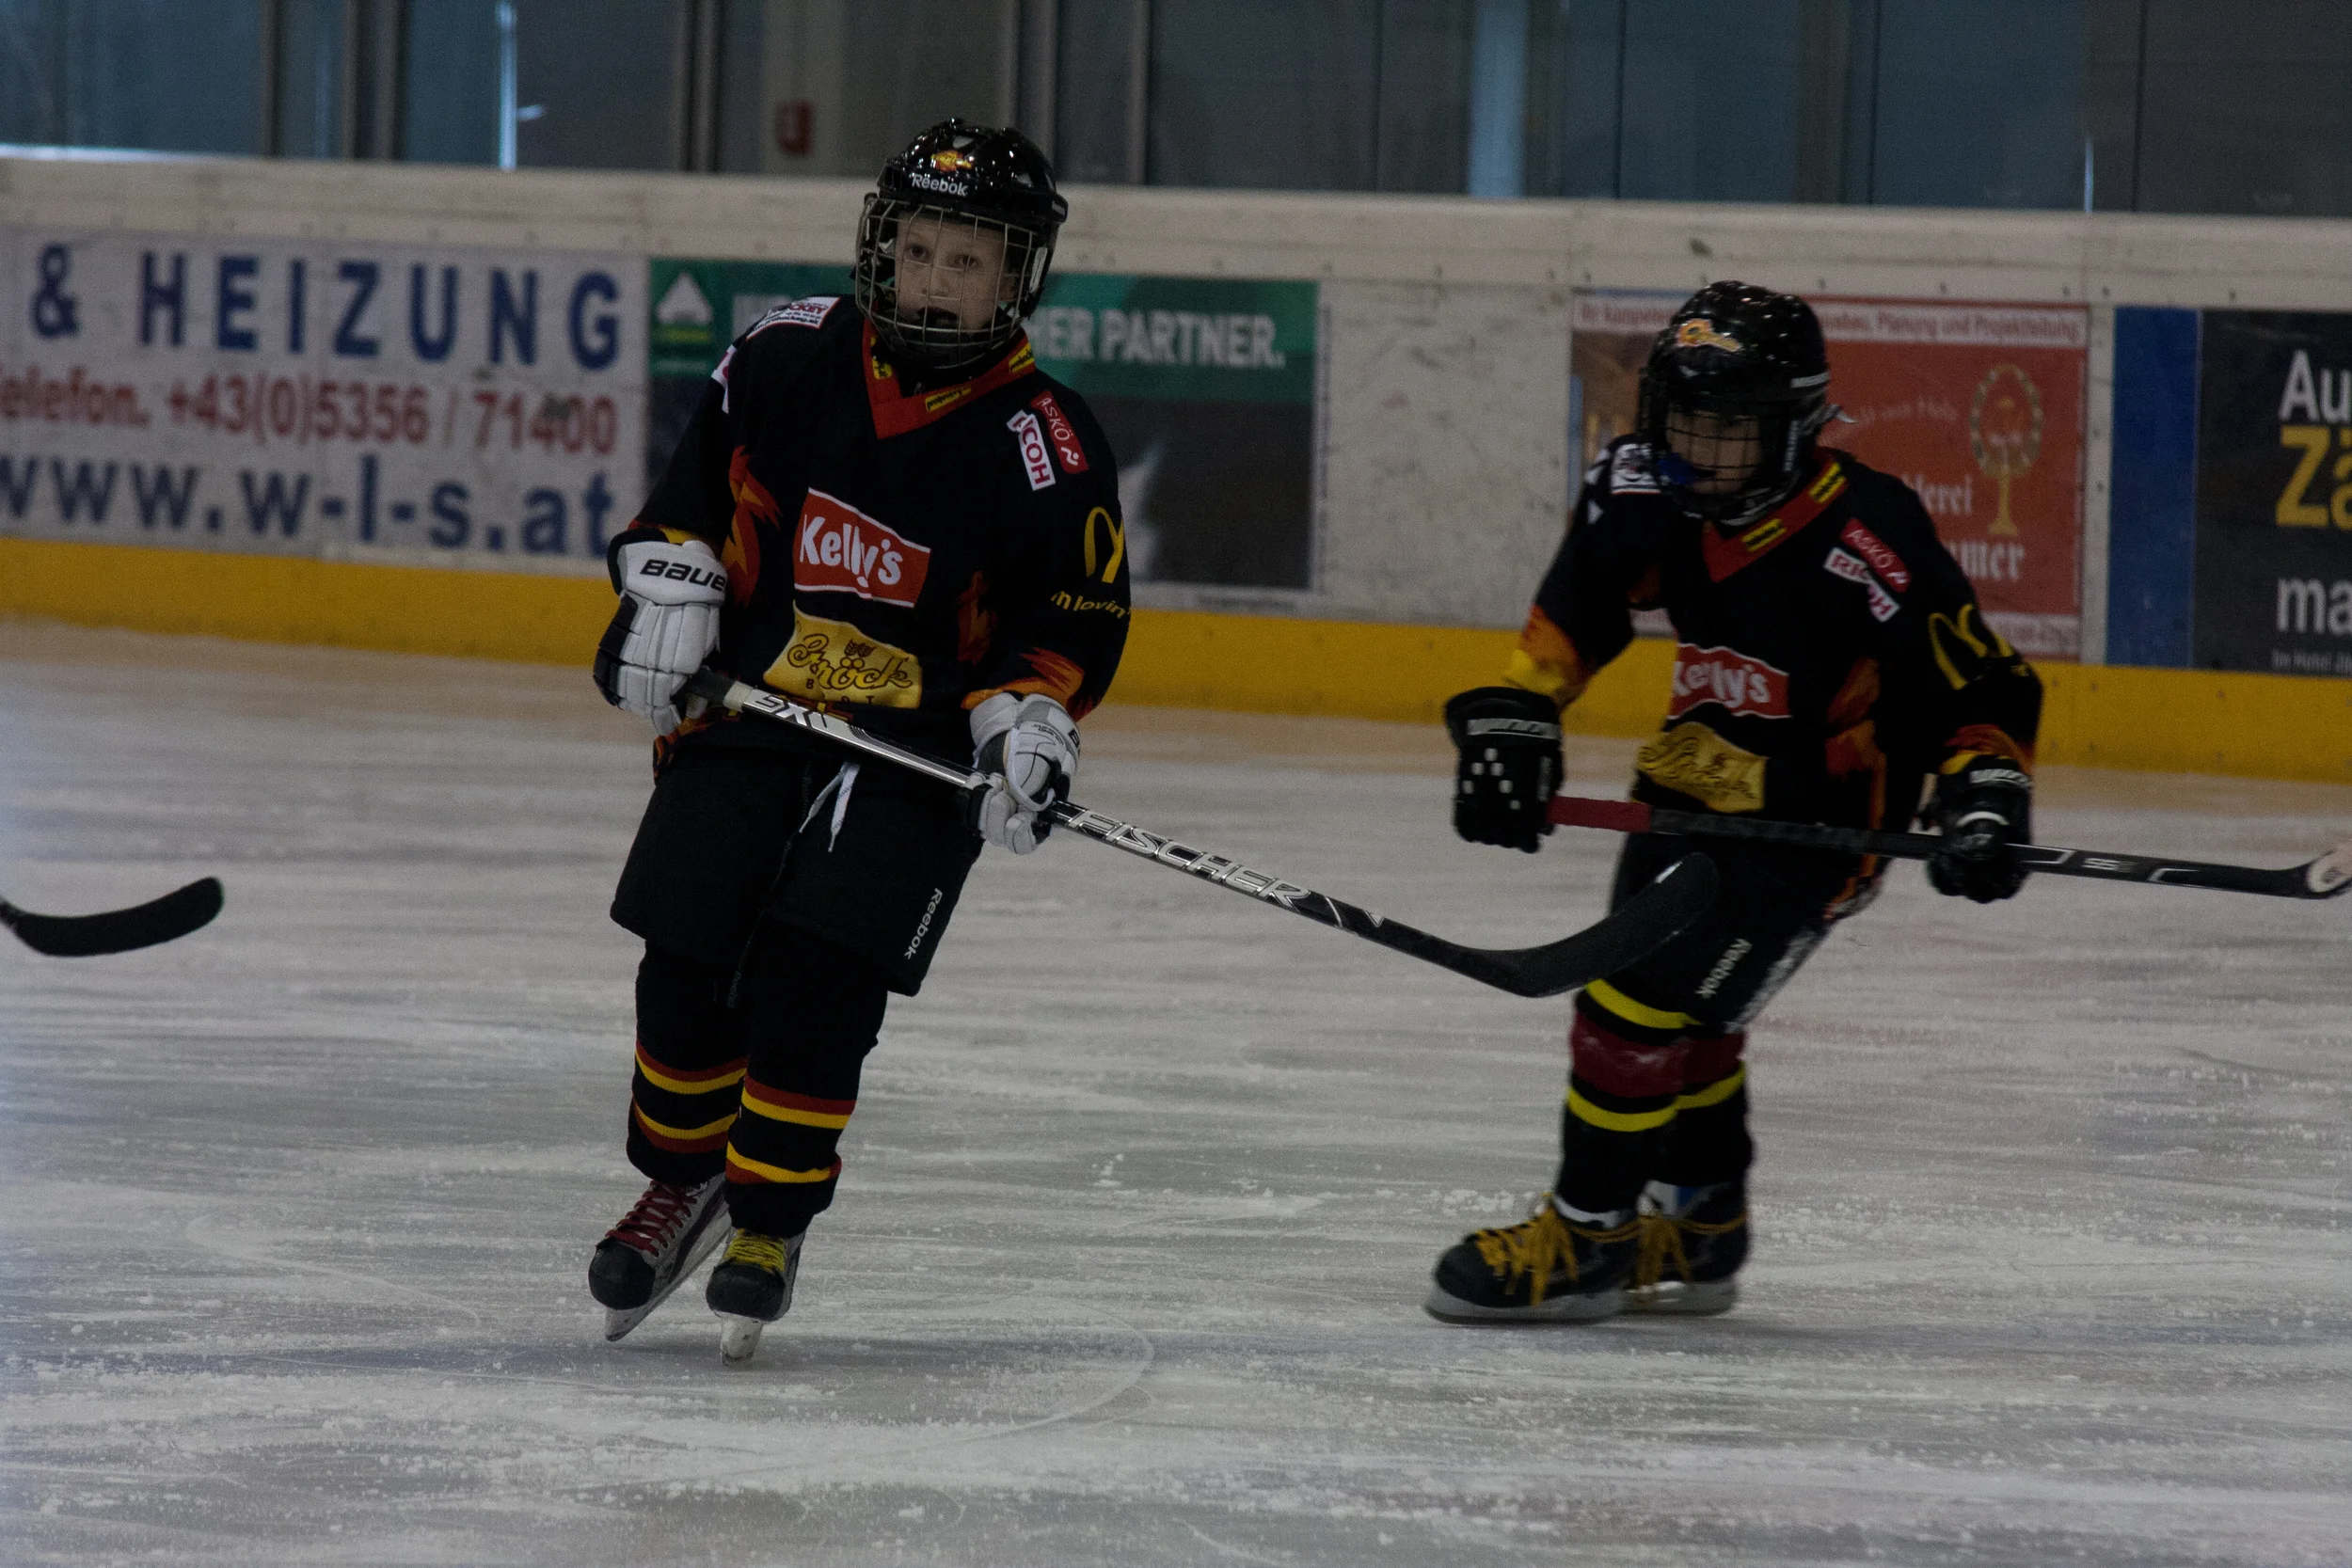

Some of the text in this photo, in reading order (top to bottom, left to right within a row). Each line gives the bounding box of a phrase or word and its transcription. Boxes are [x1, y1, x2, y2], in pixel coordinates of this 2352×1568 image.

[911, 173, 968, 197] Reebok
[33, 244, 78, 339] &
[140, 251, 619, 370] HEIZUNG
[1098, 308, 1286, 368] PARTNER.
[0, 366, 151, 426] elefon.
[167, 373, 429, 447] +43(0)5356
[473, 392, 618, 453] 71400
[1037, 397, 1075, 441] ASKÖ
[800, 514, 903, 588] Kelly's
[1066, 809, 1311, 913] FISCHER
[904, 887, 943, 959] Reebok
[1694, 938, 1753, 1001] Reebok
